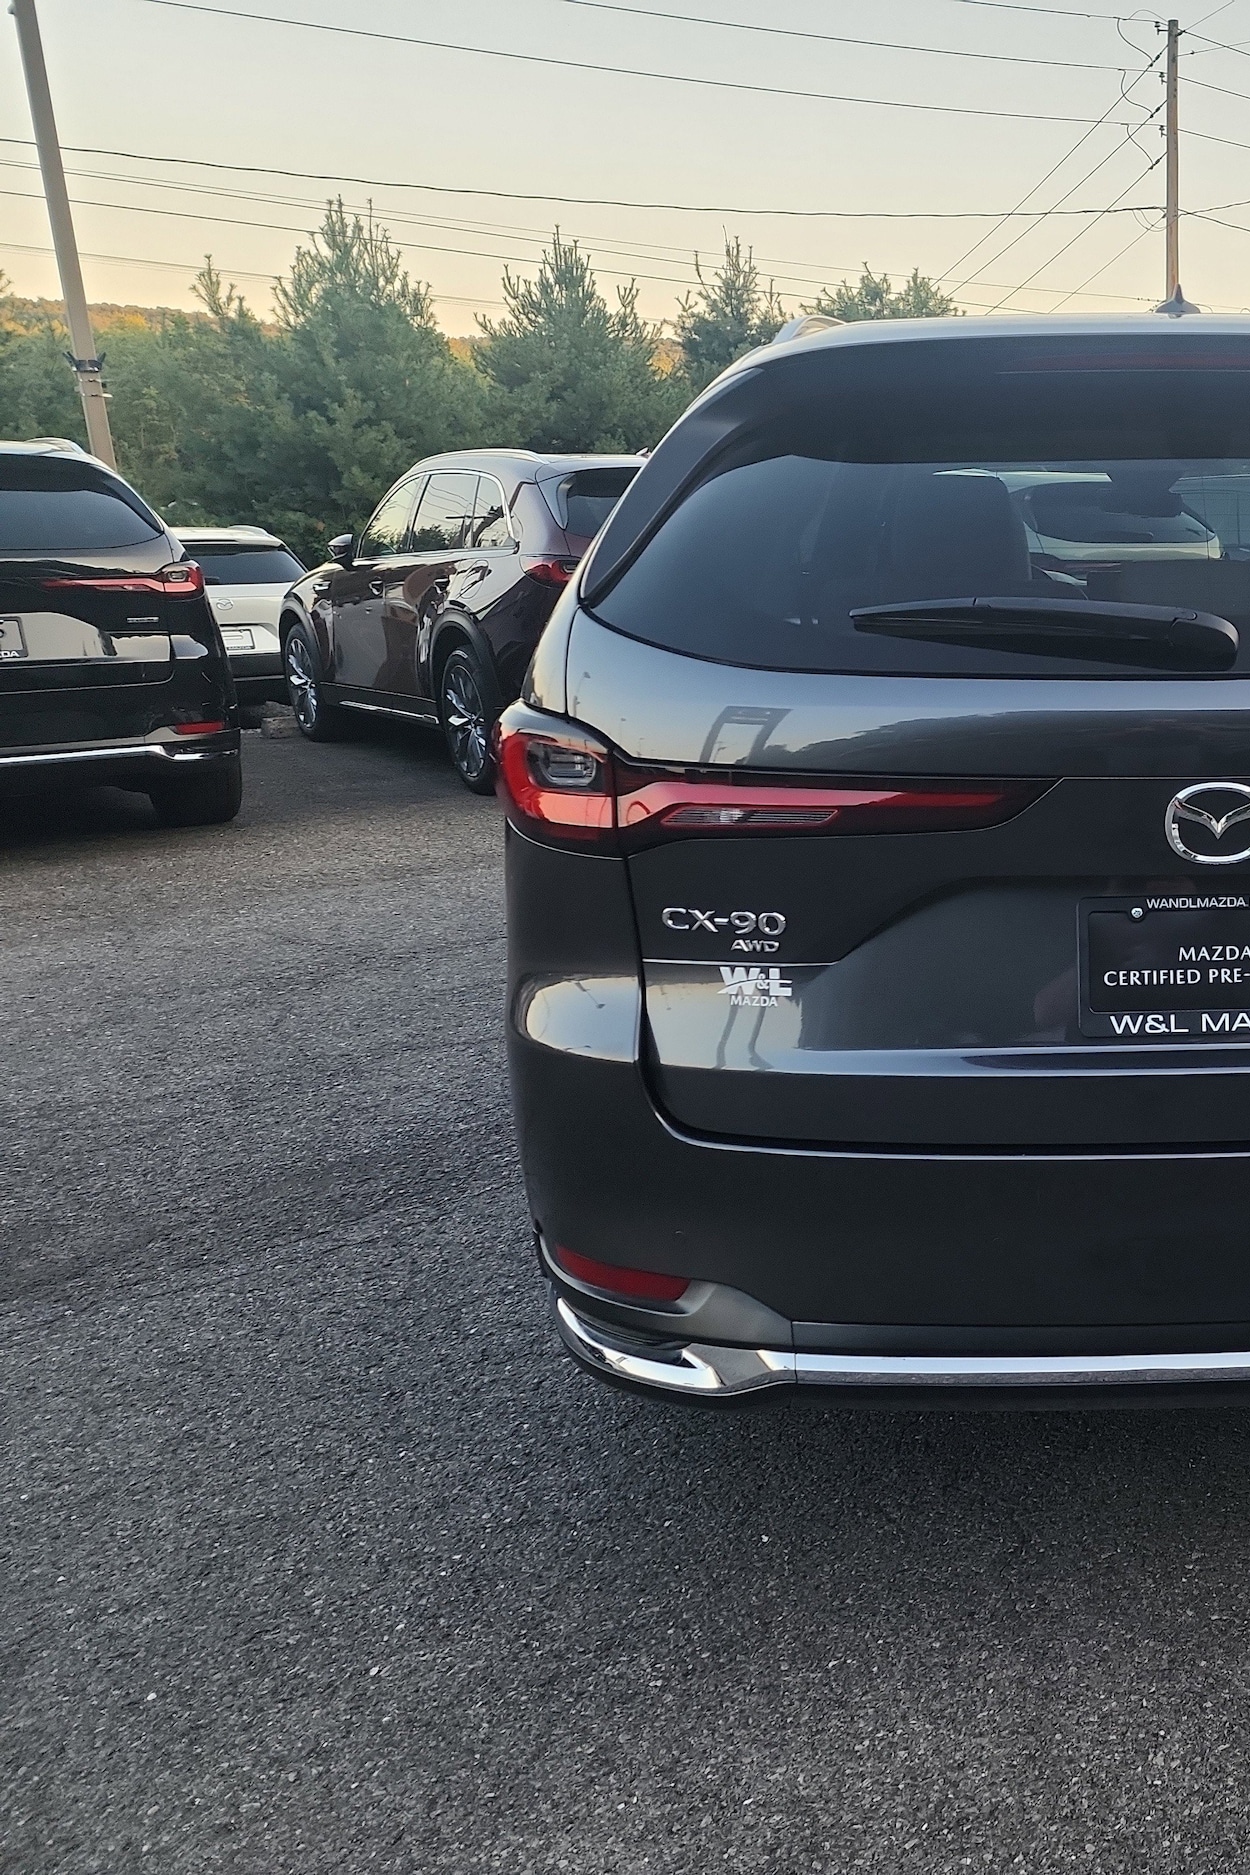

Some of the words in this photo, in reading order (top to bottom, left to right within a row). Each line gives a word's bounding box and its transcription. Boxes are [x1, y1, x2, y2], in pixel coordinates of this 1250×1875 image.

[661, 907, 787, 936] CX-90
[730, 939, 780, 953] AWD
[717, 966, 793, 997] W&L
[1103, 968, 1201, 987] CERTIFIED
[730, 995, 778, 1007] MAZDA
[1109, 1014, 1190, 1035] W&L
